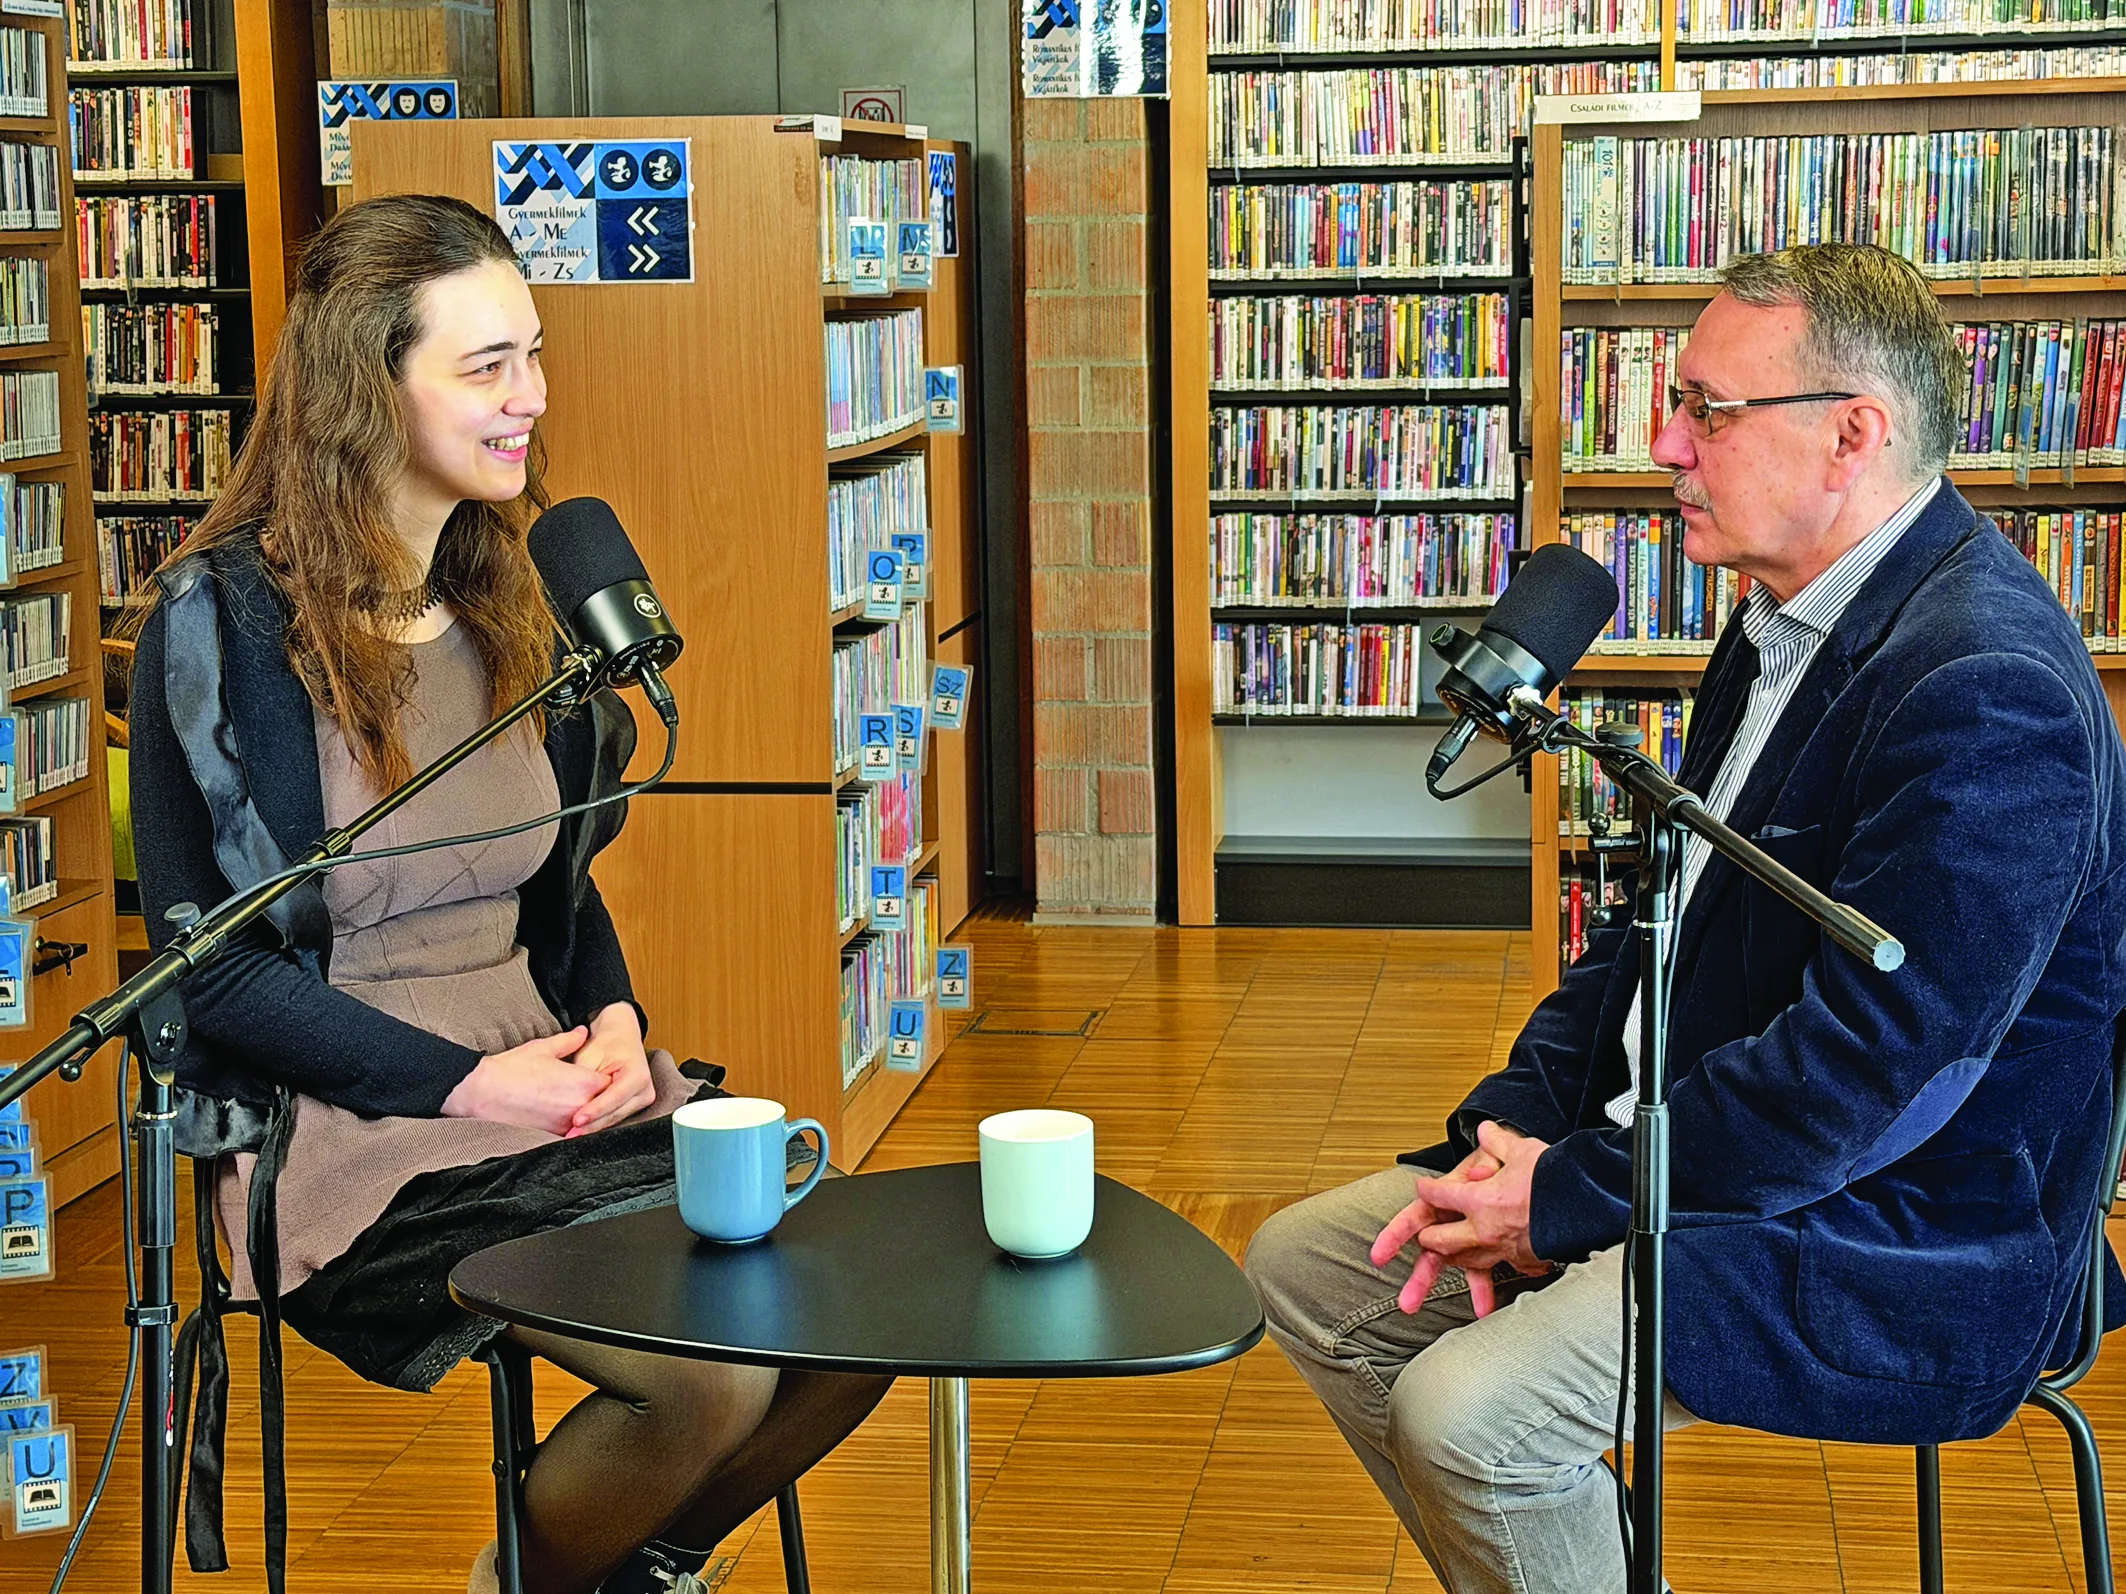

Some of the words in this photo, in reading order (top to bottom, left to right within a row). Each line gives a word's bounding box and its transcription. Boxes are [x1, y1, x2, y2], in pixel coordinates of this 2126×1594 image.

[1602, 149, 1614, 167] 101
[510, 223, 523, 241] A
[518, 246, 588, 259] yermekfilmek
[932, 375, 950, 398] N
[872, 555, 896, 581] O
[867, 718, 889, 744] R
[901, 709, 914, 734] S
[876, 870, 897, 895] T
[943, 952, 961, 976] Z
[897, 1011, 917, 1037] U
[5, 1189, 35, 1225] P
[0, 1362, 28, 1398] Z
[24, 1441, 55, 1479] U
